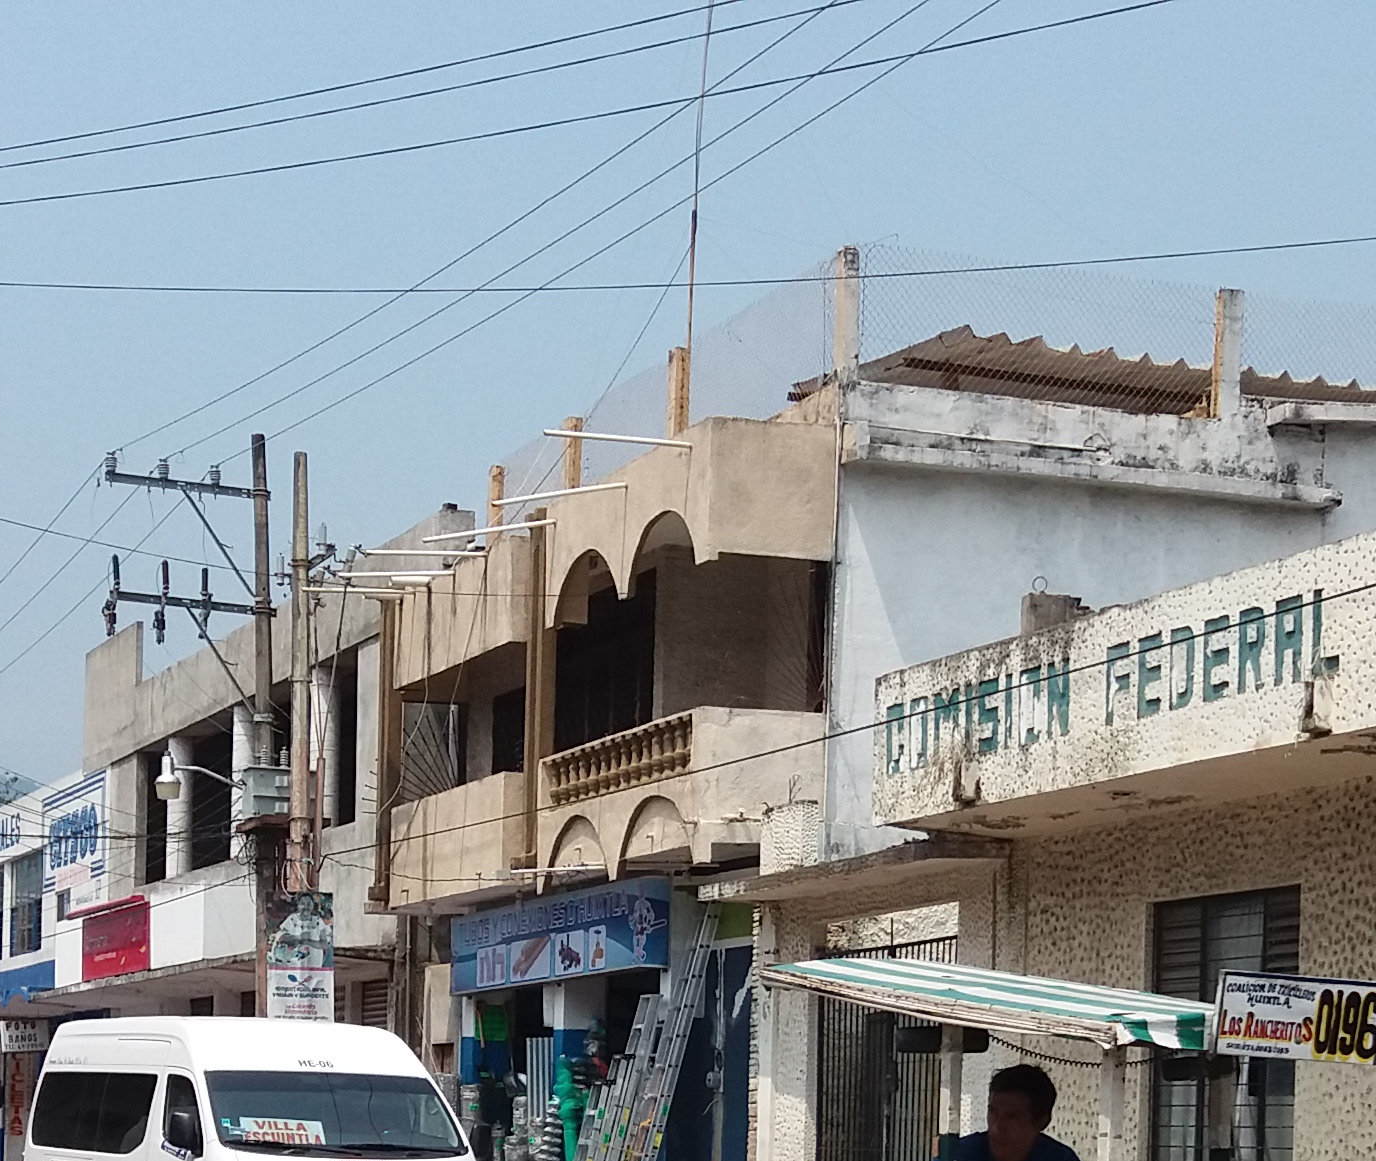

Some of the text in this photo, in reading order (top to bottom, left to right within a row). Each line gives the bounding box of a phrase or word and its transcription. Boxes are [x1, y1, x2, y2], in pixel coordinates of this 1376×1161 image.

[885, 656, 1072, 776] COMISION
[1105, 587, 1341, 727] FEDERAL
[459, 919, 490, 944] TUBOS
[500, 901, 565, 939] CONEXIONES
[1246, 992, 1292, 1009] HUIXTLA
[6, 1021, 36, 1031] FOTO
[298, 1058, 334, 1069] HE-06
[253, 1119, 307, 1132] VILLA
[244, 1131, 322, 1145] ESCUINTLA
